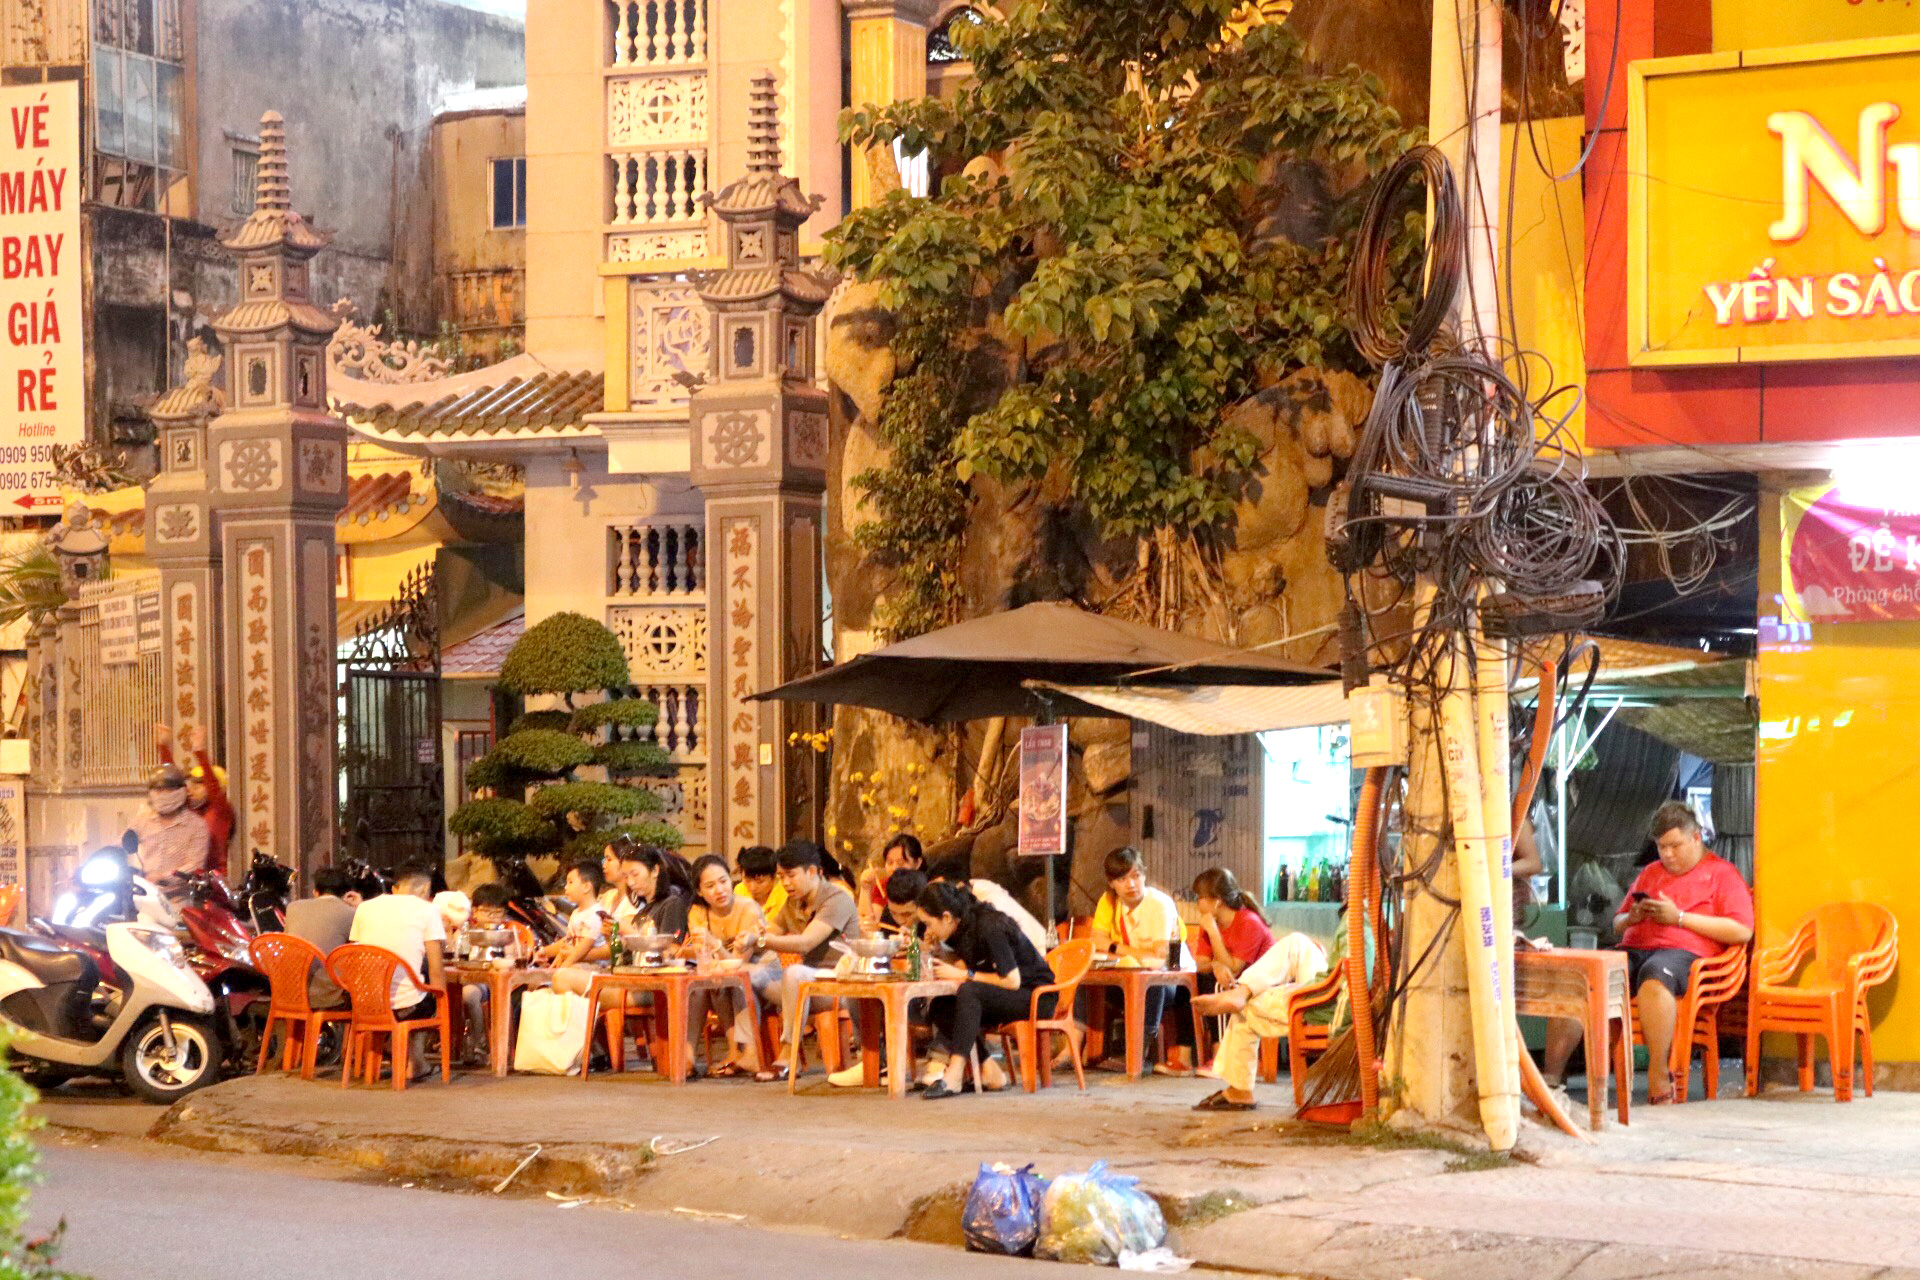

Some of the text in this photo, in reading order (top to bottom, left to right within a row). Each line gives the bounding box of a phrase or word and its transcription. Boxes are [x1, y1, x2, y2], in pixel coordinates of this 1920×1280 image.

[11, 92, 49, 150] VÉ
[0, 157, 67, 215] MÁY
[2, 233, 64, 279] BAY
[8, 288, 60, 346] GIÁ
[1703, 257, 1814, 325] YẾN
[17, 350, 57, 412] RẺ
[18, 422, 56, 437] Hotline
[1833, 585, 1888, 606] Phòng
